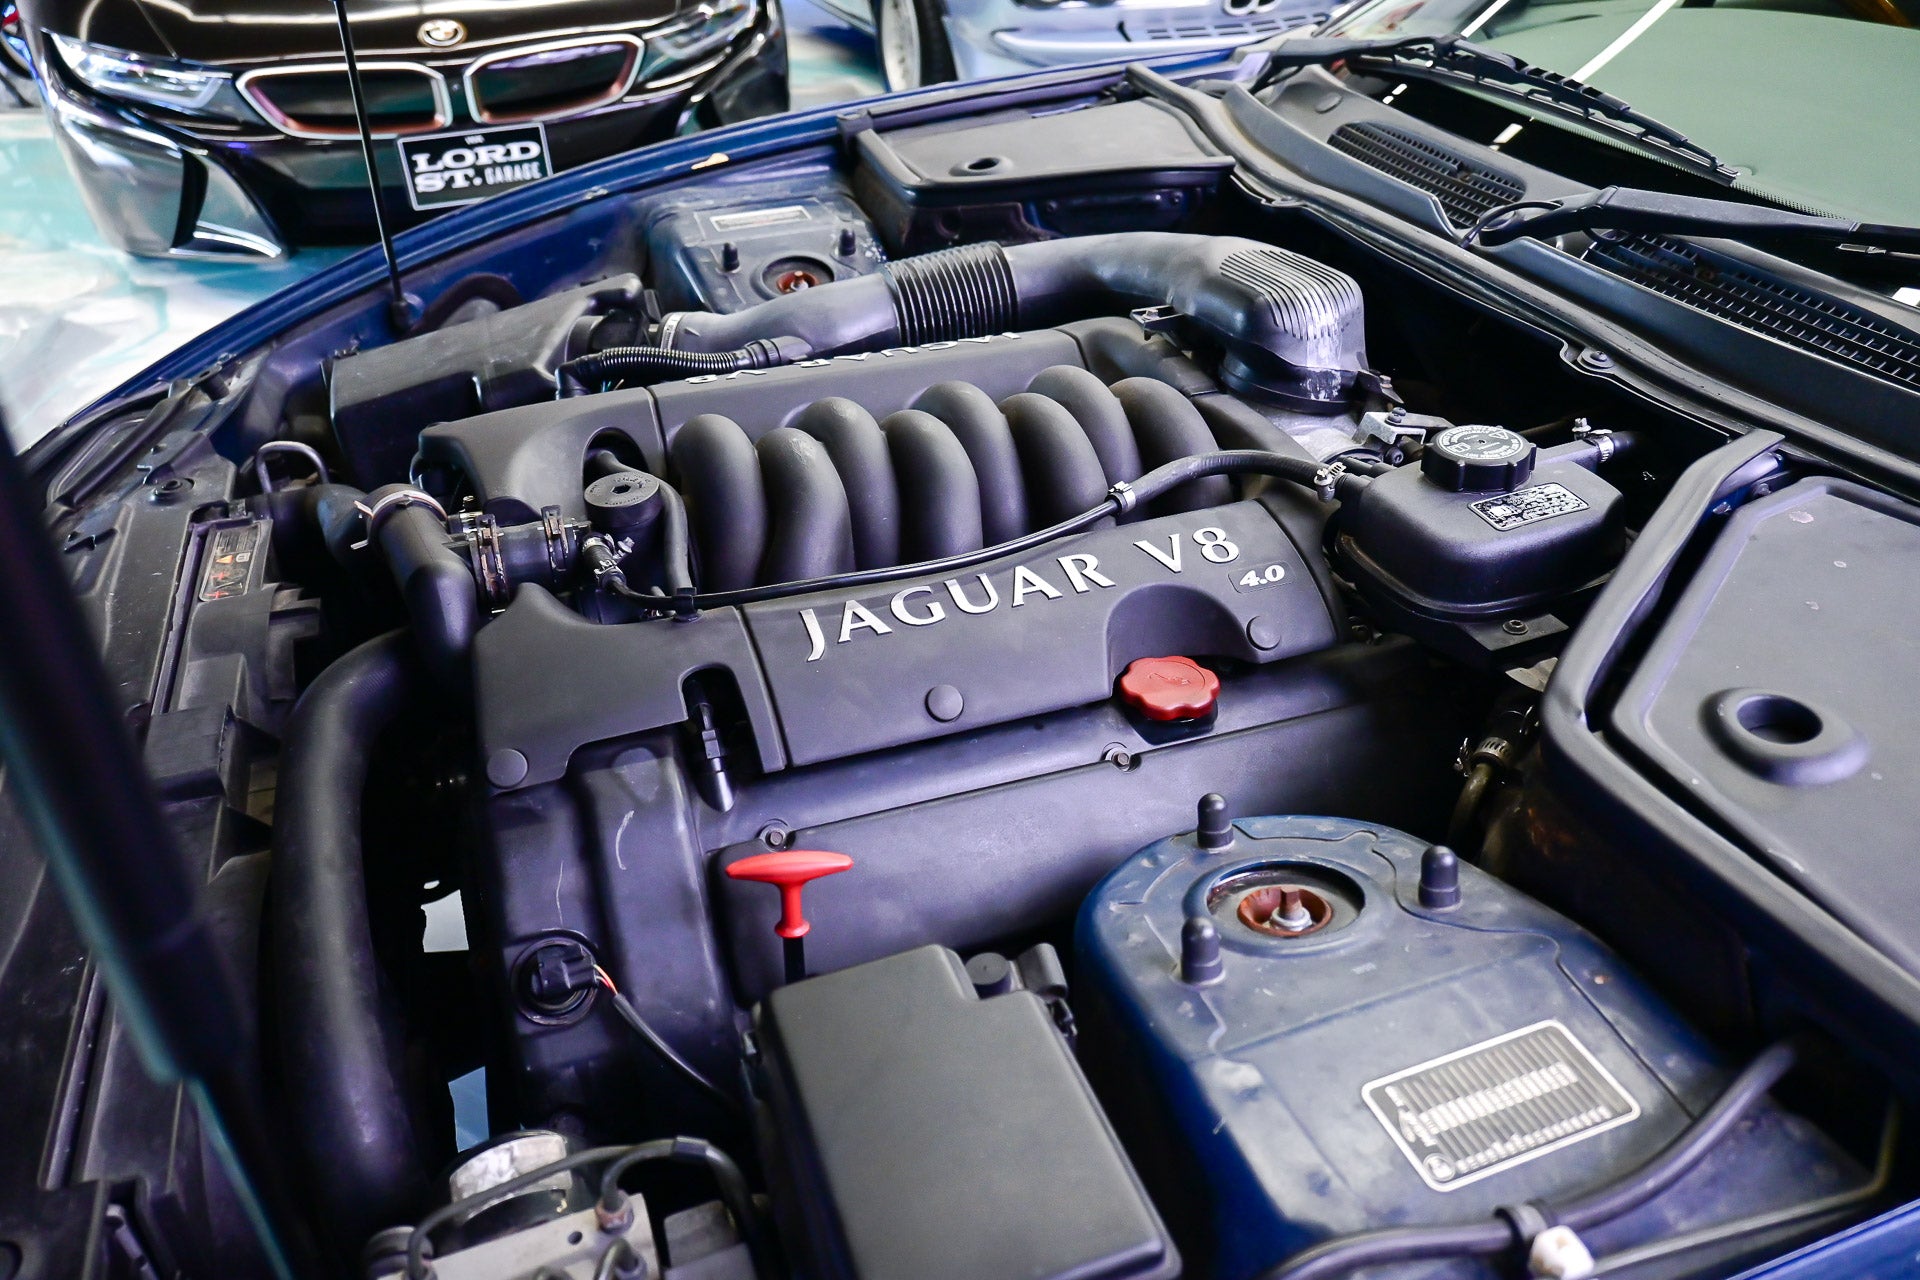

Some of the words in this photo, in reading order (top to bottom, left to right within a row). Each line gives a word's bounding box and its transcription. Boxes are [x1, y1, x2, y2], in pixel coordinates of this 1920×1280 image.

[411, 140, 542, 173] LORD
[414, 167, 483, 193] ST.
[484, 161, 543, 185] GARAGE
[1239, 564, 1286, 587] 4.0
[799, 553, 1116, 662] JAGUAR
[1133, 526, 1240, 573] V8
